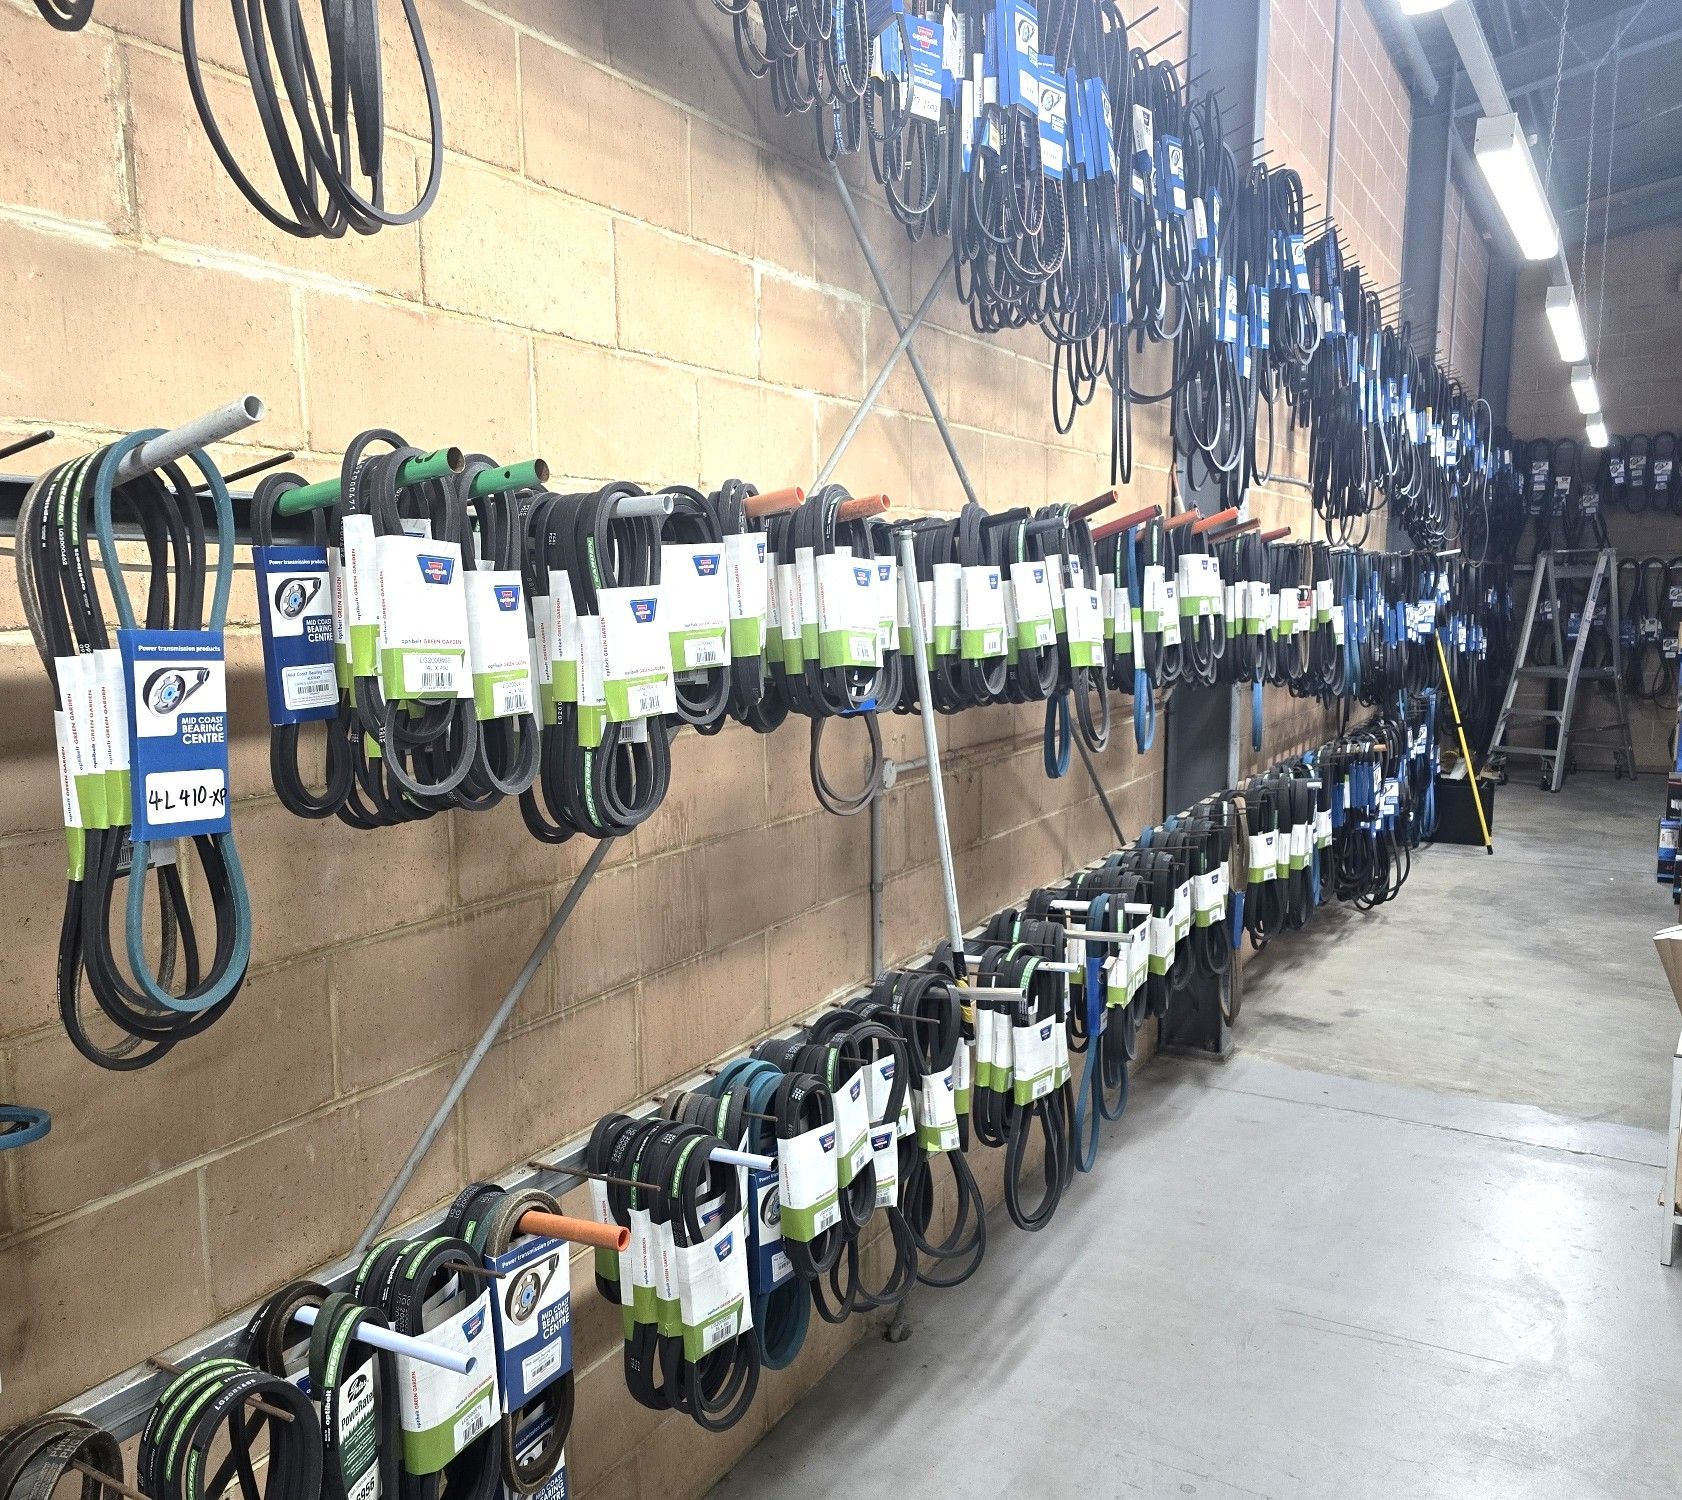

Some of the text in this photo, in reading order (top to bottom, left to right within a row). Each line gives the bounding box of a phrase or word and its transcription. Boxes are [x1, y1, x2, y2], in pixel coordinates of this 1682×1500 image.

[912, 32, 938, 46] optibelt
[74, 548, 86, 591] optibelt
[307, 625, 332, 633] BEARING
[308, 633, 333, 643] CENTRE
[196, 645, 221, 653] products
[182, 716, 224, 725] MID COAST
[182, 724, 224, 733] BEARING
[182, 733, 225, 744] CENTRE
[502, 1257, 517, 1268] Power
[518, 1243, 547, 1261] transmission
[387, 1255, 403, 1284] optibelt
[541, 1297, 570, 1322] MID COAST
[541, 1305, 570, 1330] BEARING
[543, 1316, 570, 1340] CENTRE
[327, 1342, 341, 1384] GREEN
[341, 1391, 374, 1432] PoweRate
[540, 1481, 564, 1500] EARING
[546, 1472, 564, 1491] COAST
